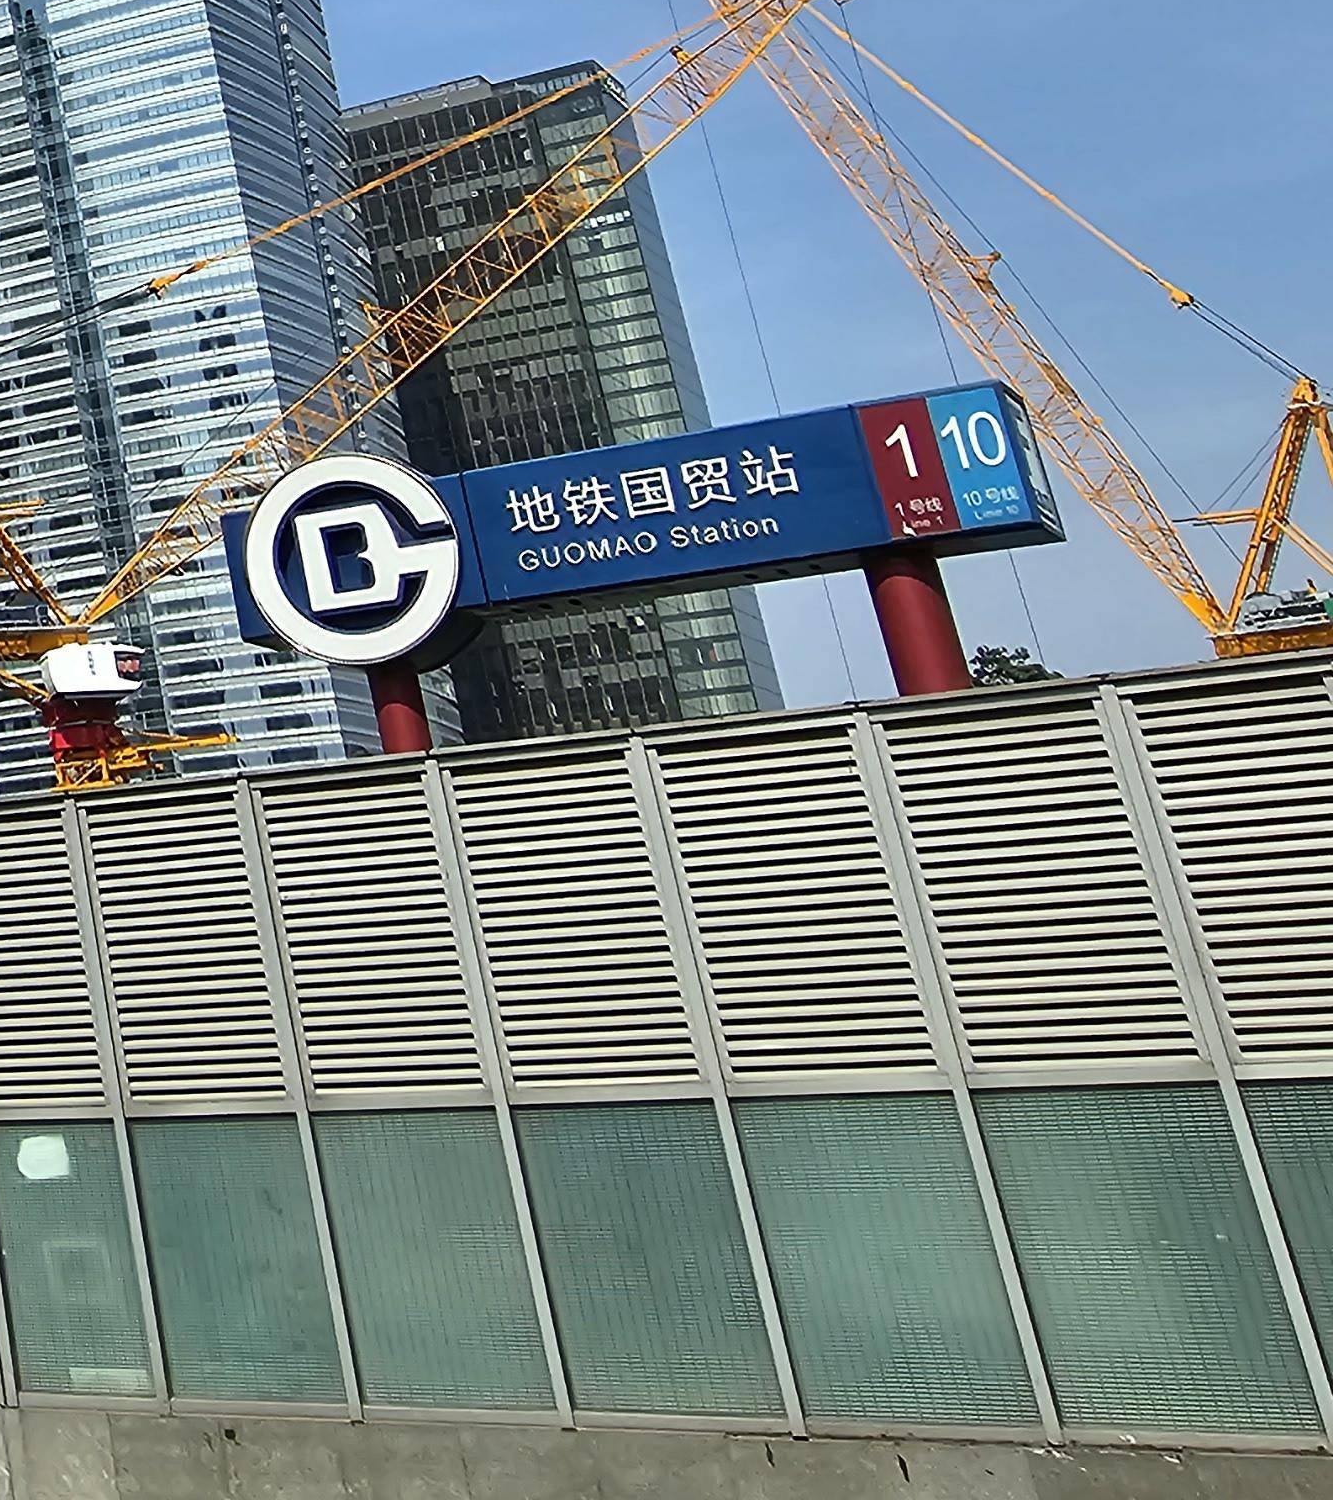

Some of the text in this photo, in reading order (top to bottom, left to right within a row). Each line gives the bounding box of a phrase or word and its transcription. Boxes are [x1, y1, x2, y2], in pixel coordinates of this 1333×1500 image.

[884, 423, 919, 478] 1
[940, 411, 1007, 469] 10
[505, 445, 800, 533] 地铁国贸站
[894, 502, 906, 517] 1
[962, 490, 983, 507] 10
[517, 516, 780, 572] GUOMAO Station
